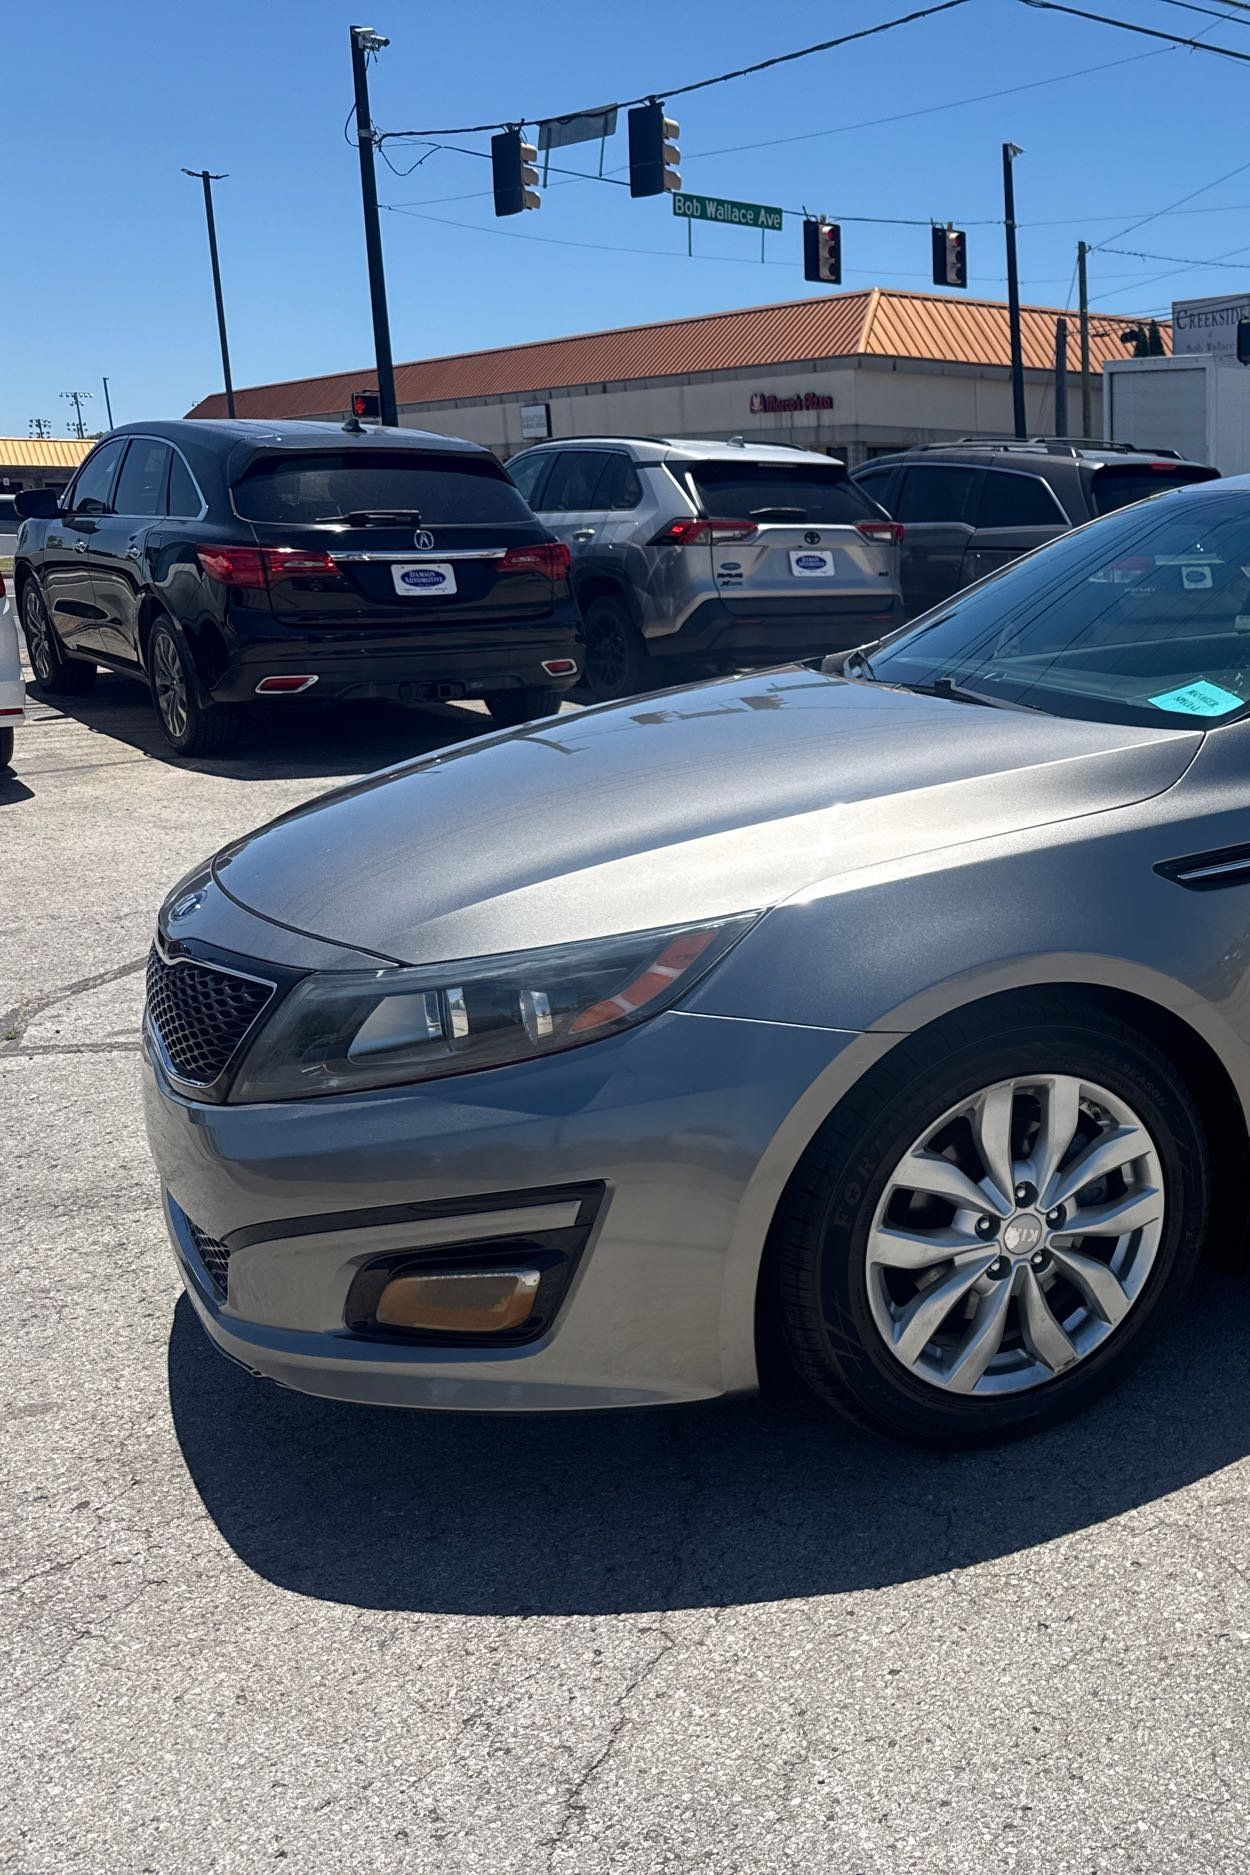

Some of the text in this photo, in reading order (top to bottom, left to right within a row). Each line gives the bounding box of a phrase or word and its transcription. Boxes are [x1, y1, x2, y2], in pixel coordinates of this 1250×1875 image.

[674, 195, 781, 228] Bob Wallace Ave
